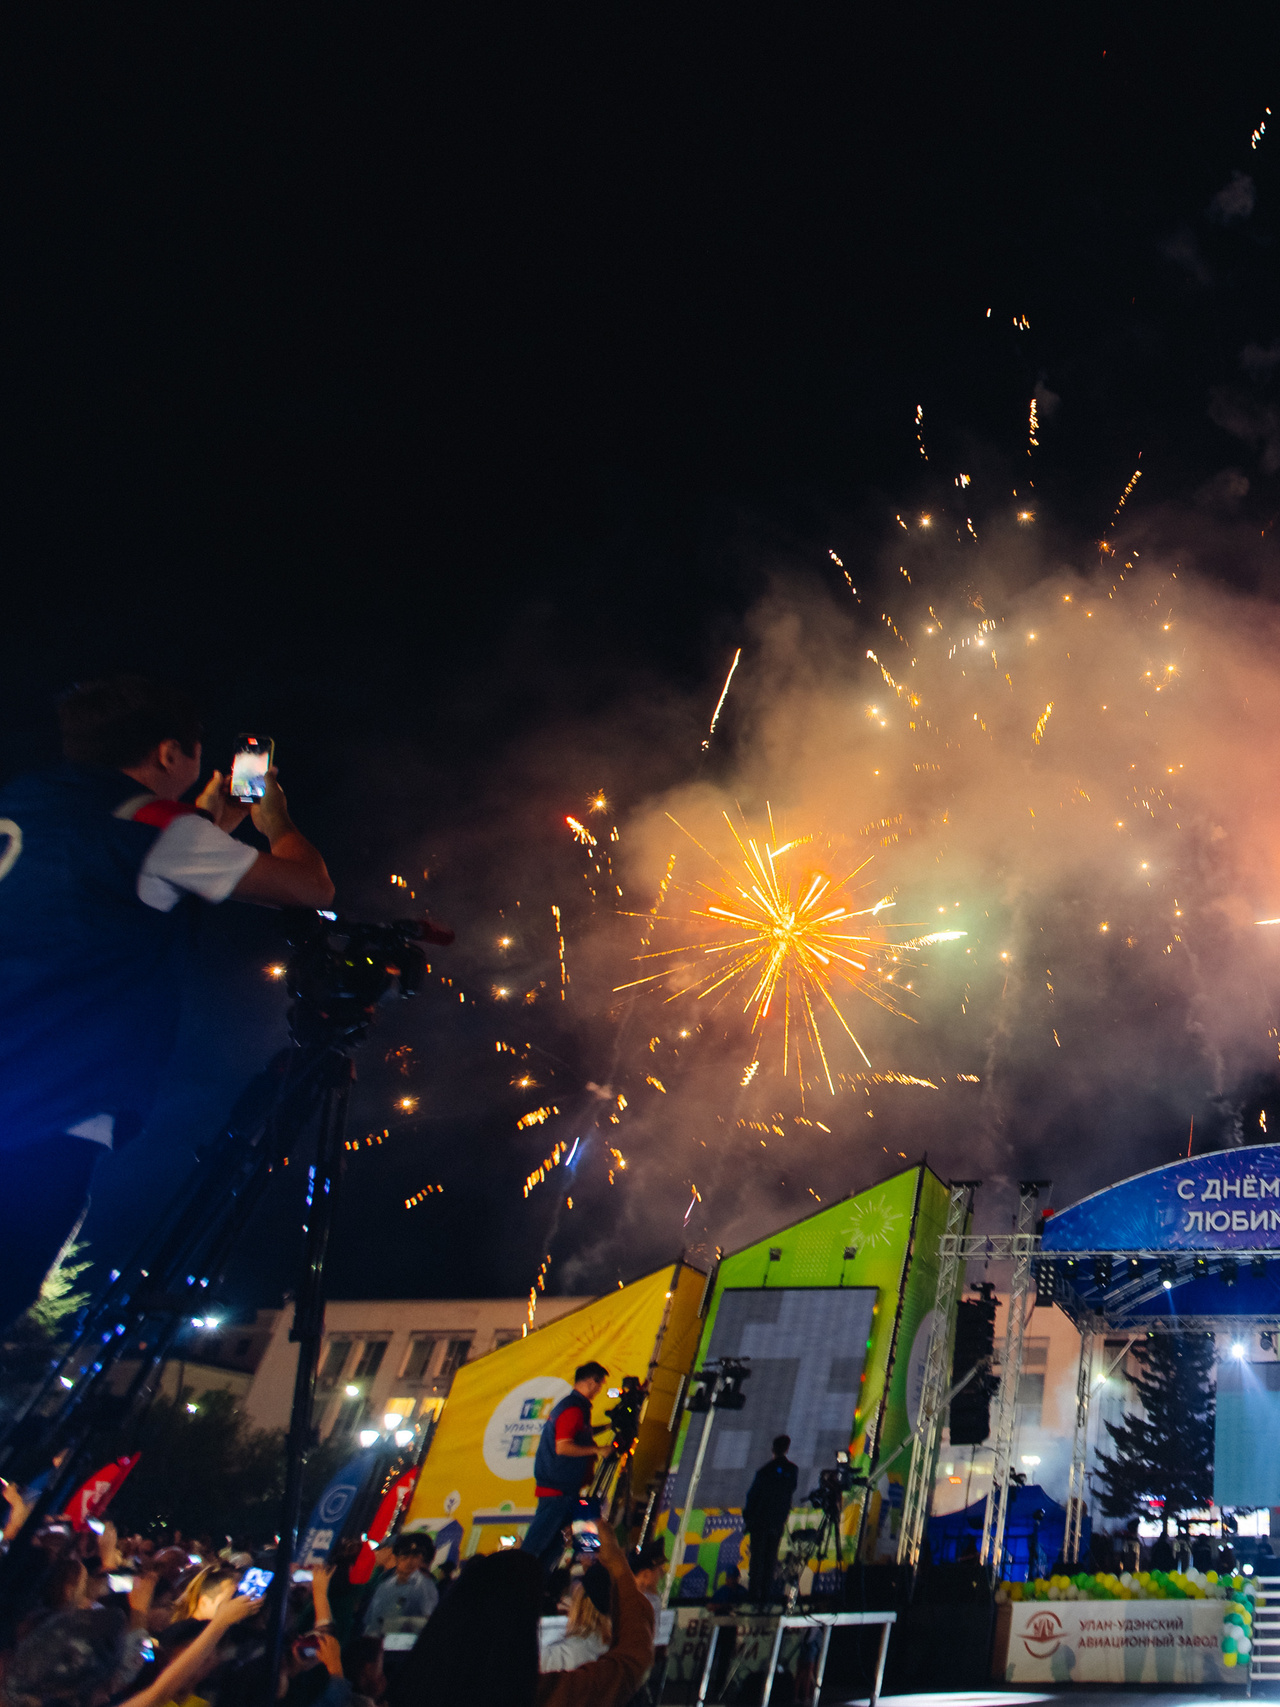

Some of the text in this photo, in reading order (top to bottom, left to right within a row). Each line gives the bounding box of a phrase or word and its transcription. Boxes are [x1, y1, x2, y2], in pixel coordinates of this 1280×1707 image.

[1176, 1179, 1196, 1200] С
[1200, 1174, 1280, 1201] ДНЁМ
[1078, 1616, 1184, 1632] УЛАН-УДЭНСКИЙ
[1077, 1633, 1220, 1649] АВИАЦИОННЫЙ ЗАВОД
